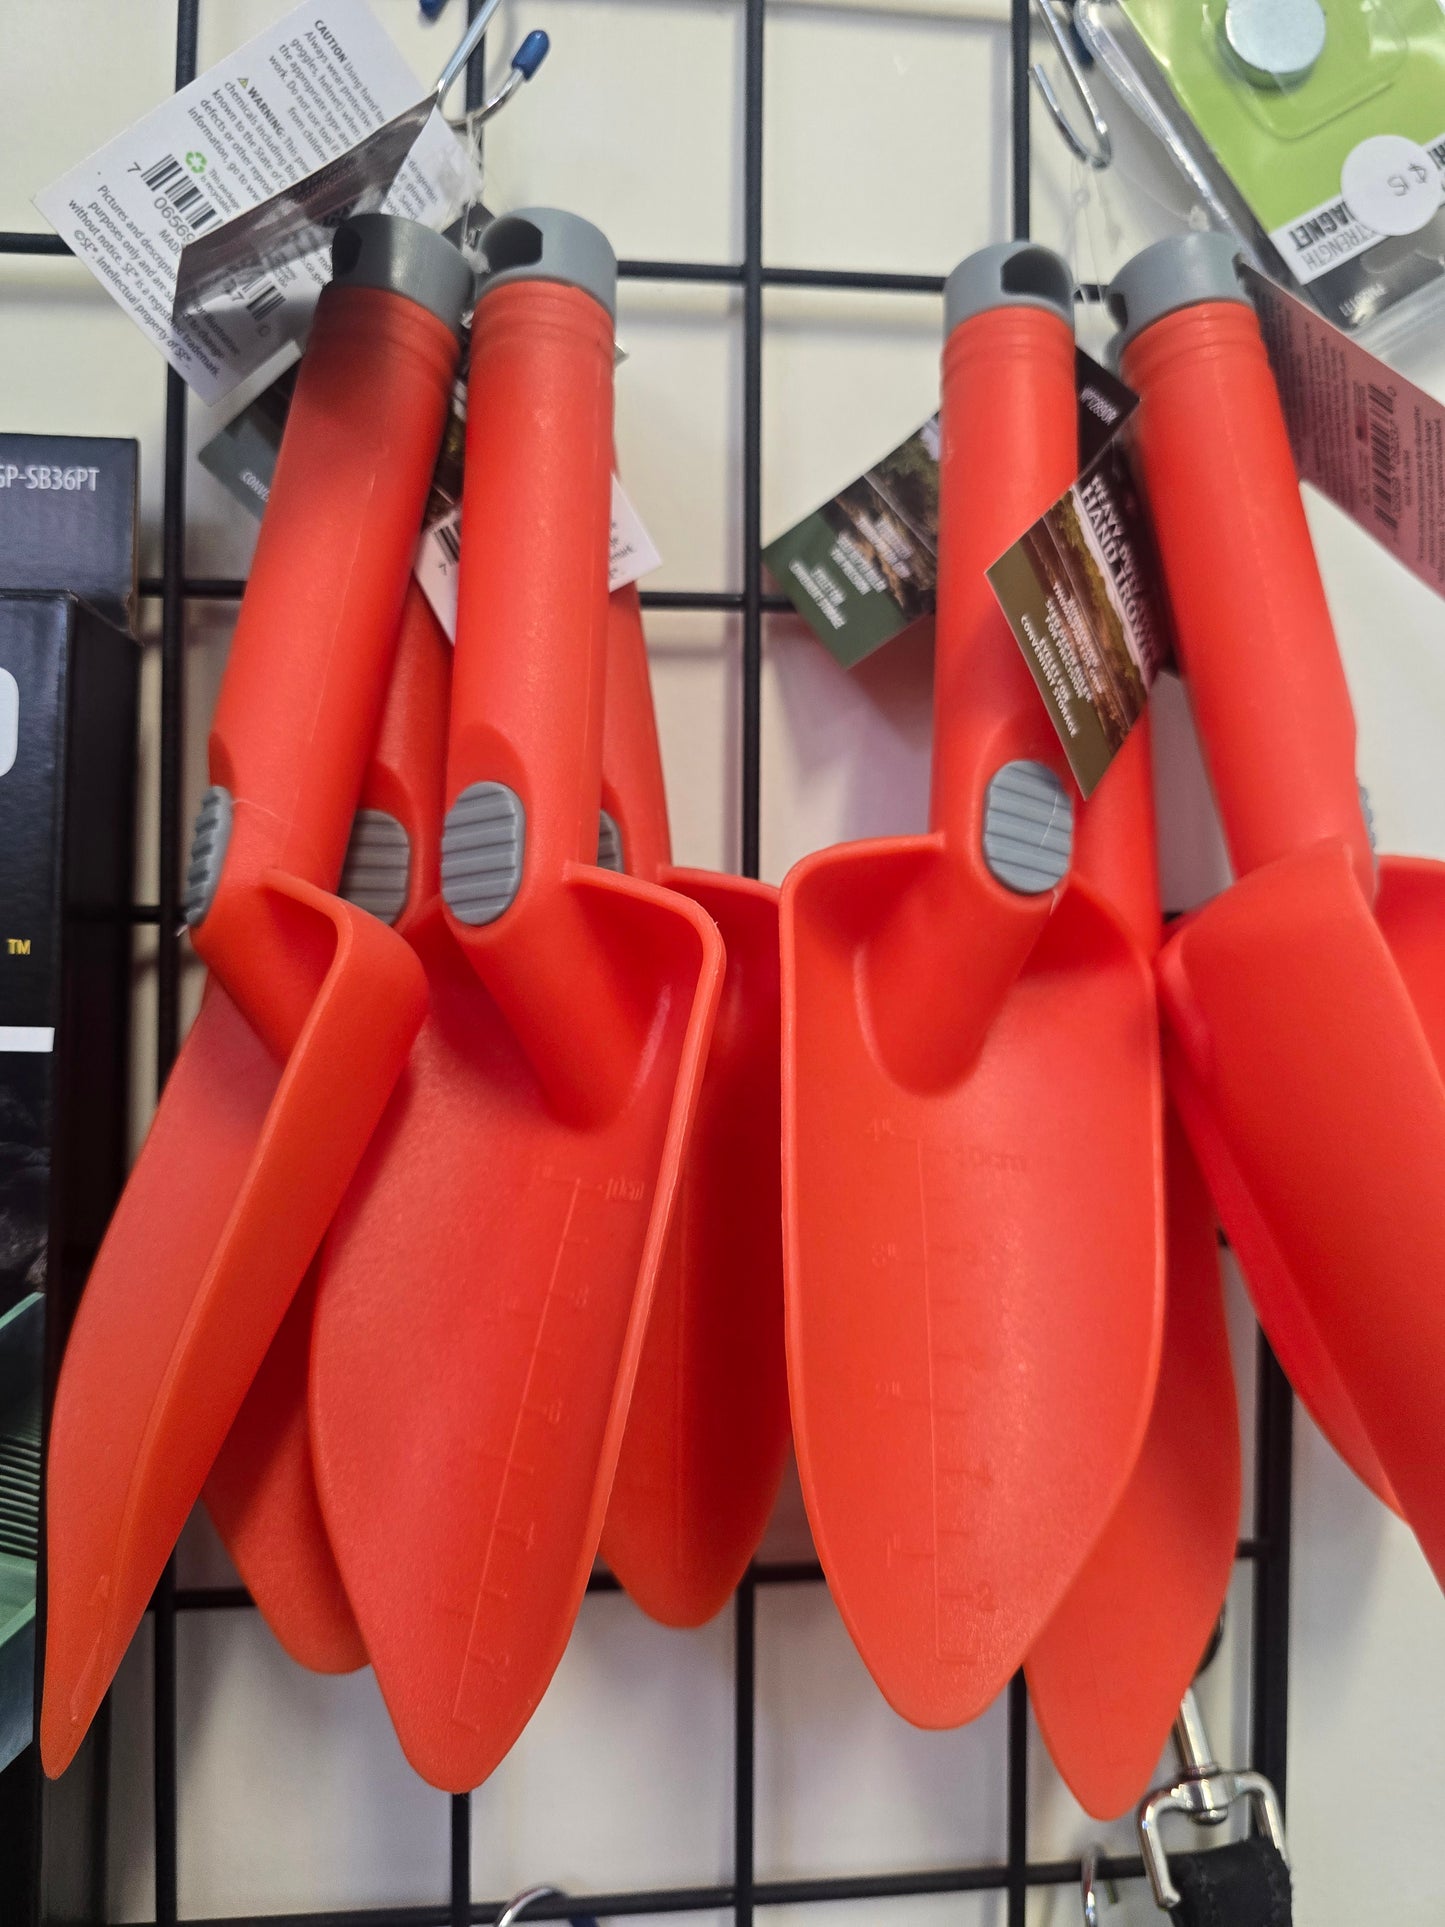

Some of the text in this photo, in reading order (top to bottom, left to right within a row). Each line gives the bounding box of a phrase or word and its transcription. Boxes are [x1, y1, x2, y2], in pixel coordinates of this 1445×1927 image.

[267, 55, 290, 81] work.
[286, 80, 300, 95] Do
[296, 94, 310, 111] not
[307, 111, 320, 127] use
[318, 127, 334, 145] tool
[279, 44, 293, 60] the
[288, 61, 328, 112] appropriate
[323, 112, 341, 132] type
[289, 37, 322, 77] goggles,
[341, 112, 361, 135] when
[302, 30, 330, 64] Always
[326, 63, 343, 85] wear
[340, 86, 373, 127] protective
[313, 19, 348, 62] CAUTION
[341, 62, 364, 89] Using
[359, 88, 379, 111] hand
[187, 106, 230, 161] information,
[227, 162, 239, 175] go
[238, 174, 248, 184] to
[200, 98, 228, 131] defects
[223, 131, 233, 142] or
[231, 141, 253, 166] other
[212, 89, 238, 121] known
[235, 121, 245, 132] to
[242, 131, 257, 148] the
[254, 147, 273, 169] State
[270, 169, 281, 180] of
[224, 81, 259, 125] chemicals
[254, 124, 288, 166] including
[246, 87, 287, 138] WARNING:
[283, 138, 298, 156] This
[287, 107, 306, 129] from
[126, 162, 141, 176] 7
[208, 169, 221, 184] This
[68, 198, 101, 235] without
[97, 233, 125, 264] notice.
[135, 278, 145, 289] is
[88, 200, 126, 243] purposes
[121, 239, 142, 261] only
[138, 259, 155, 277] and
[152, 277, 166, 291] are
[97, 185, 129, 221] Pictures
[126, 220, 143, 239] and
[1287, 201, 1355, 251] AGNET
[96, 256, 139, 306] Intellectual
[135, 303, 169, 342] property
[166, 338, 178, 350] of
[1079, 484, 1119, 564] HAND
[1019, 614, 1077, 737] CONVENIENT STORAGE
[1037, 637, 1071, 702] EYELET FOR
[1044, 616, 1084, 698] FOR PRECISION
[7, 938, 31, 955] TM
